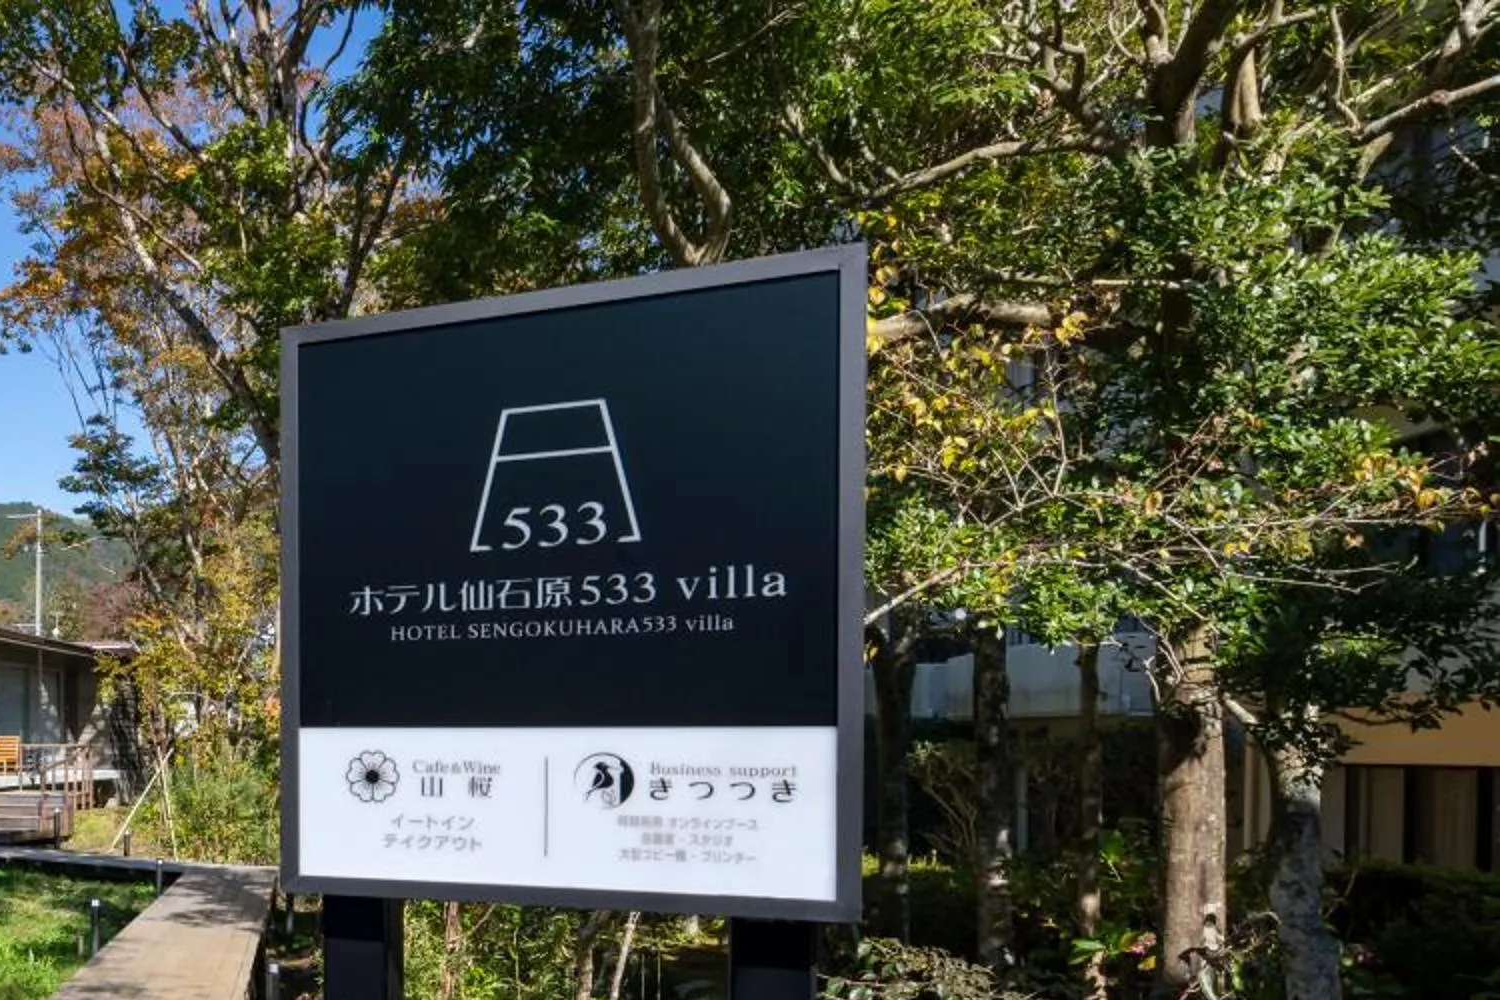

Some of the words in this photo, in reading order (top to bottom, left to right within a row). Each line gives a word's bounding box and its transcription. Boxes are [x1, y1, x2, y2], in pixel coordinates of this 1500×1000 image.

[501, 500, 608, 550] 533
[349, 572, 658, 616] ホテル仙石原533
[676, 564, 787, 600] villa
[390, 623, 461, 641] HOTEL
[467, 616, 678, 639] SENGOKUHARA533
[685, 615, 734, 632] villa
[649, 761, 721, 776] Business
[729, 764, 798, 778] support
[649, 777, 798, 803] きつつき
[390, 812, 476, 831] イートイン
[383, 833, 483, 853] テイクアウト
